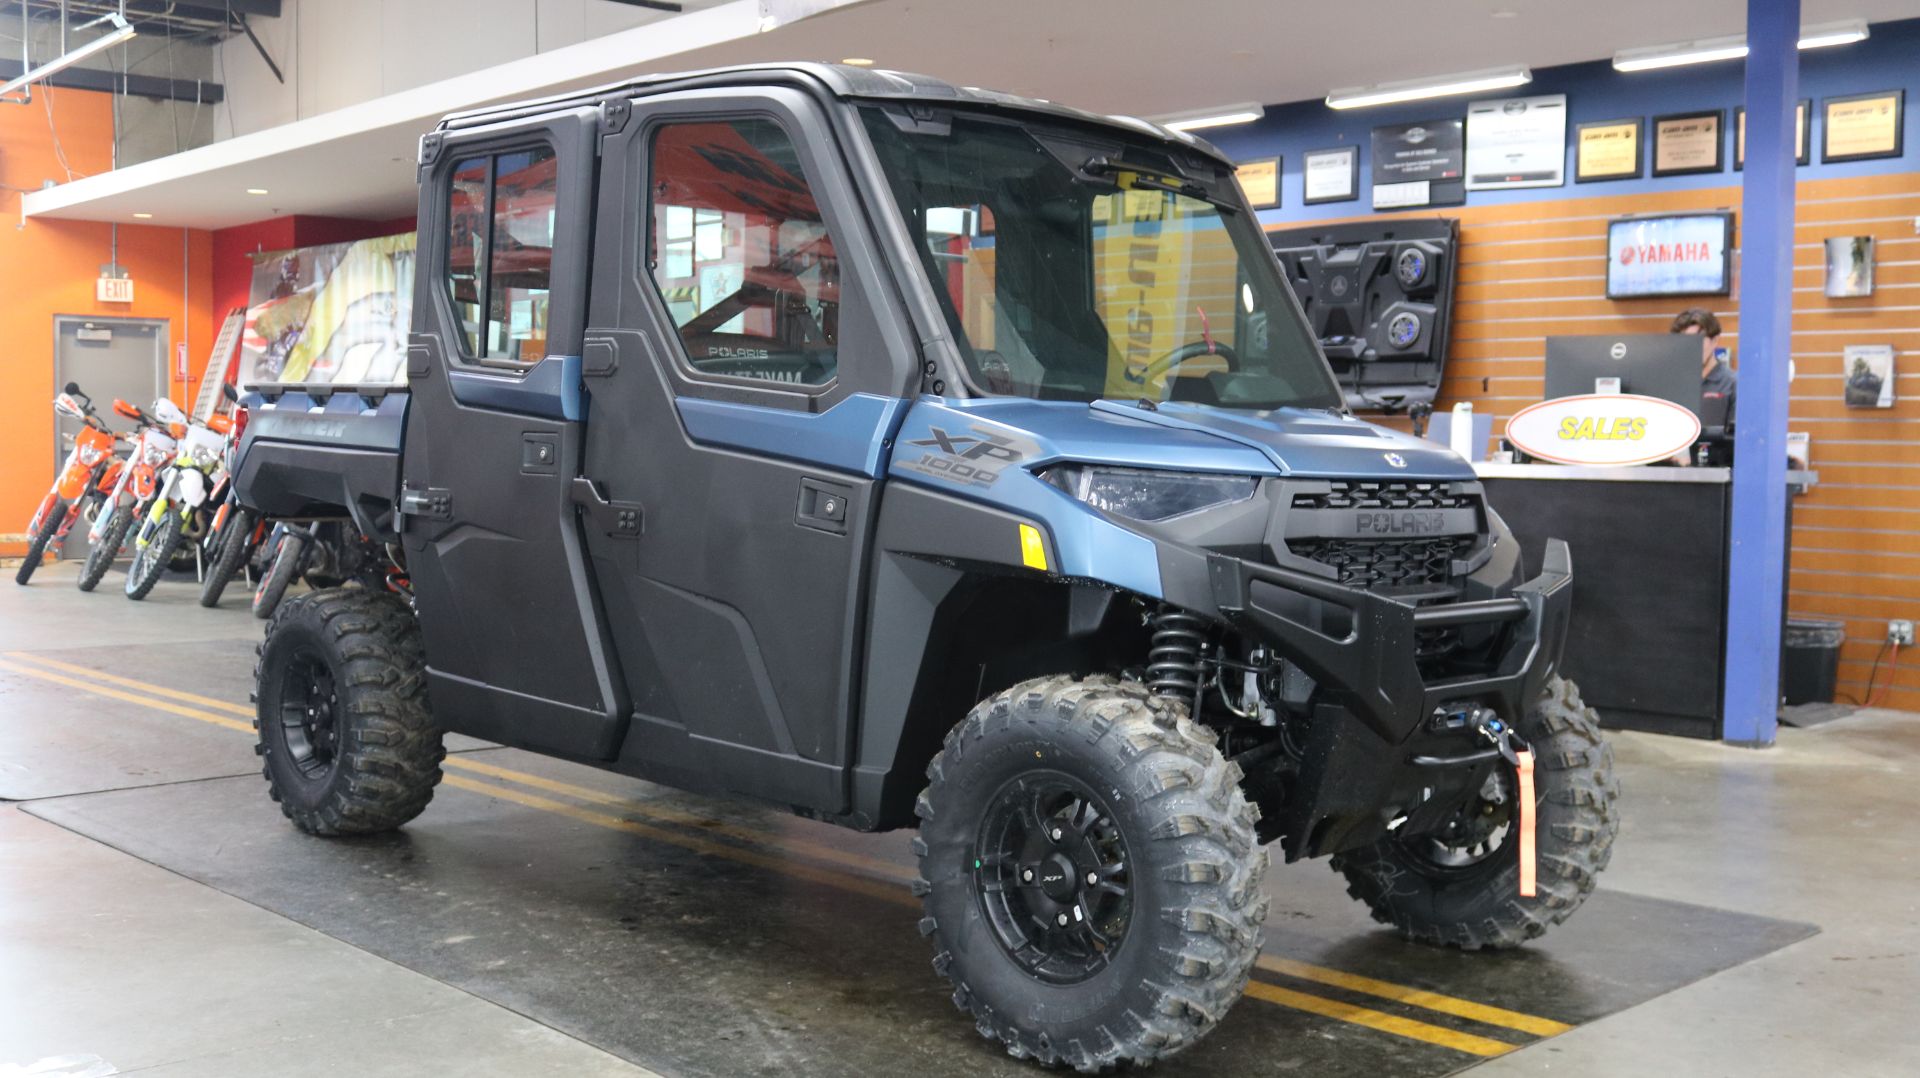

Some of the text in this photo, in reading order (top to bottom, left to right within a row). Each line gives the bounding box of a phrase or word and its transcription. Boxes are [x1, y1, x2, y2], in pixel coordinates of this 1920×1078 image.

[1638, 241, 1710, 264] YAMAHA
[105, 280, 129, 298] EXIT
[708, 346, 769, 359] POLARIS
[1557, 415, 1648, 441] SALES
[910, 426, 1024, 463] XP
[919, 454, 1000, 484] 1000
[1356, 512, 1445, 534] POLARIS
